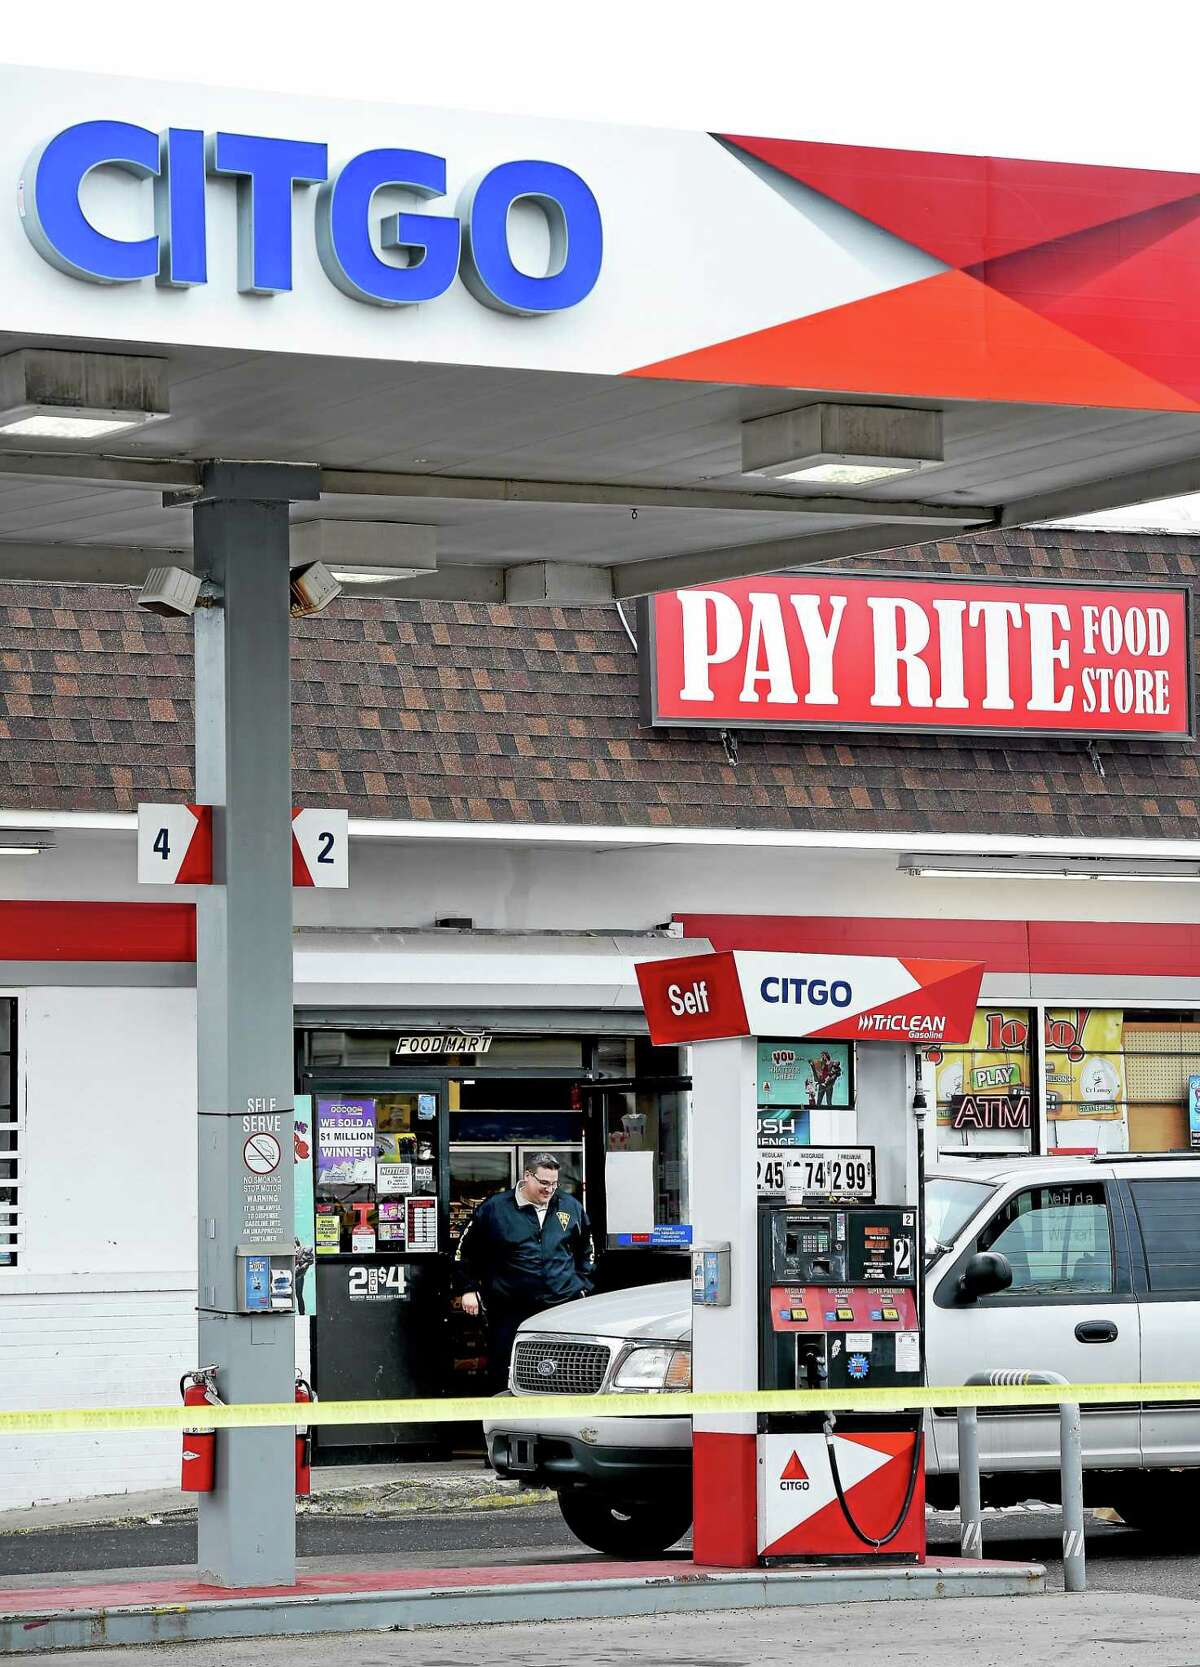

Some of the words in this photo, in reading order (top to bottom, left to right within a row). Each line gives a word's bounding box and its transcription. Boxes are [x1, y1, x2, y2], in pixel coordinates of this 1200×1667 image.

[22, 119, 604, 315] CITGO
[1081, 604, 1171, 657] FOOD
[676, 589, 848, 705] PAY
[867, 596, 1075, 712] RITE
[1081, 666, 1171, 715] STORE
[152, 827, 171, 860] 4
[317, 831, 335, 864] 2
[667, 980, 711, 1017] Self
[759, 976, 853, 1008] CITGO
[396, 1038, 442, 1053] FOOD
[445, 1036, 491, 1052] MART
[908, 1030, 943, 1039] Gasoline
[976, 1067, 1014, 1087] PLAY
[243, 1115, 281, 1132] SERVE
[321, 1119, 335, 1127] WE
[338, 1119, 363, 1127] SOLD
[366, 1119, 373, 1127] A
[954, 1095, 1031, 1128] ATM
[334, 1132, 373, 1141] MILLION
[322, 1147, 372, 1158] WINNER!
[243, 1176, 252, 1184] NO
[381, 1167, 409, 1175] NOTICE
[832, 1162, 866, 1190] 2.99
[906, 1215, 911, 1224] 2
[895, 1240, 910, 1275] 2
[349, 1267, 368, 1295] 2
[378, 1266, 407, 1294] $4
[780, 1481, 810, 1491] CITGO
